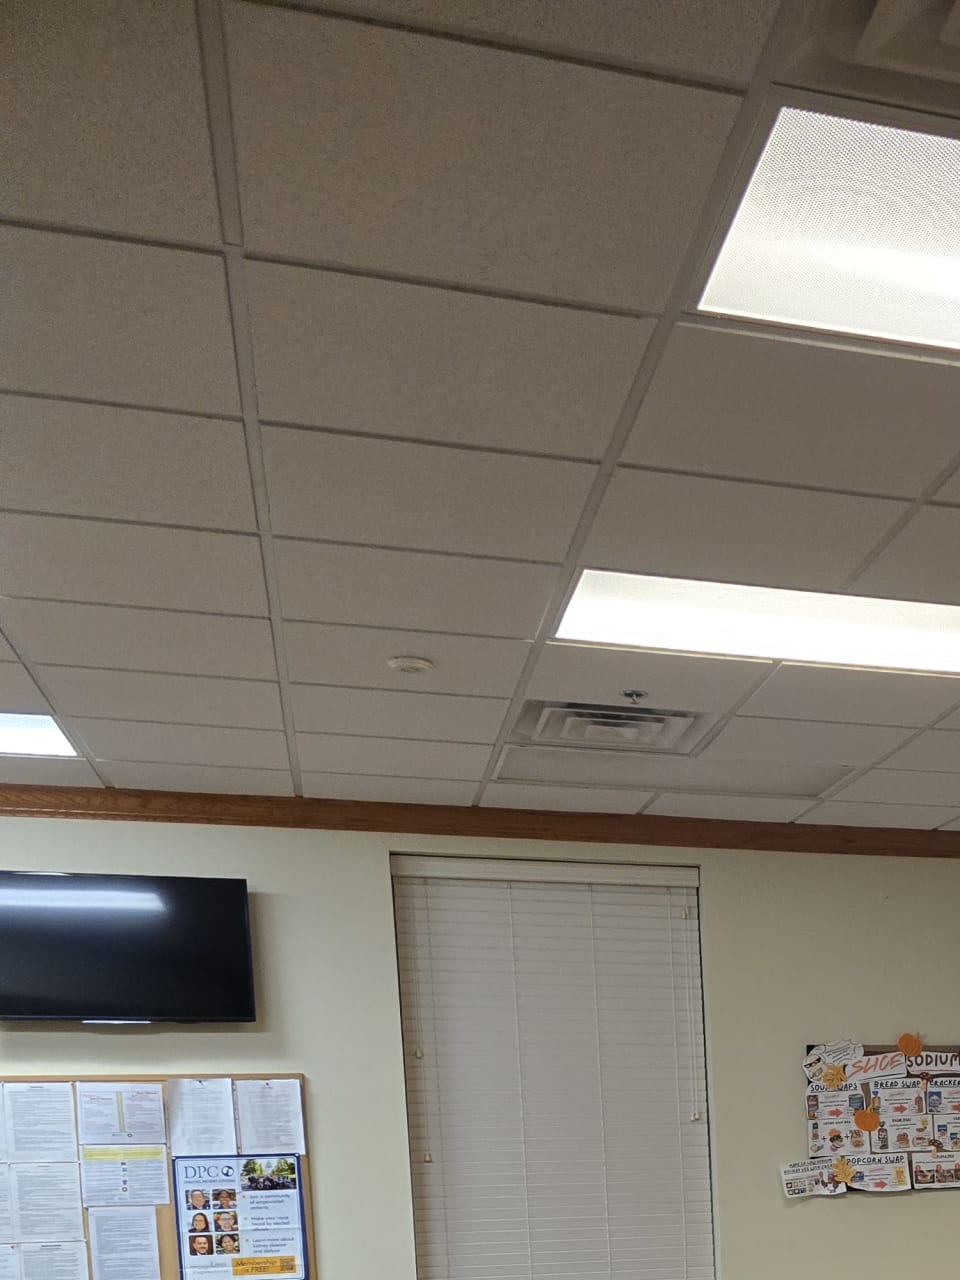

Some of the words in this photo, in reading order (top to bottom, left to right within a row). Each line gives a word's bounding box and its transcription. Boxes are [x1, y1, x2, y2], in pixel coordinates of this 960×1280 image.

[847, 1053, 904, 1079] SLICE
[873, 1080, 899, 1088] BREAD
[847, 1157, 882, 1165] POPCORN
[884, 1155, 905, 1163] SWAP
[184, 1165, 219, 1179] DPC
[235, 1259, 278, 1267] Membership
